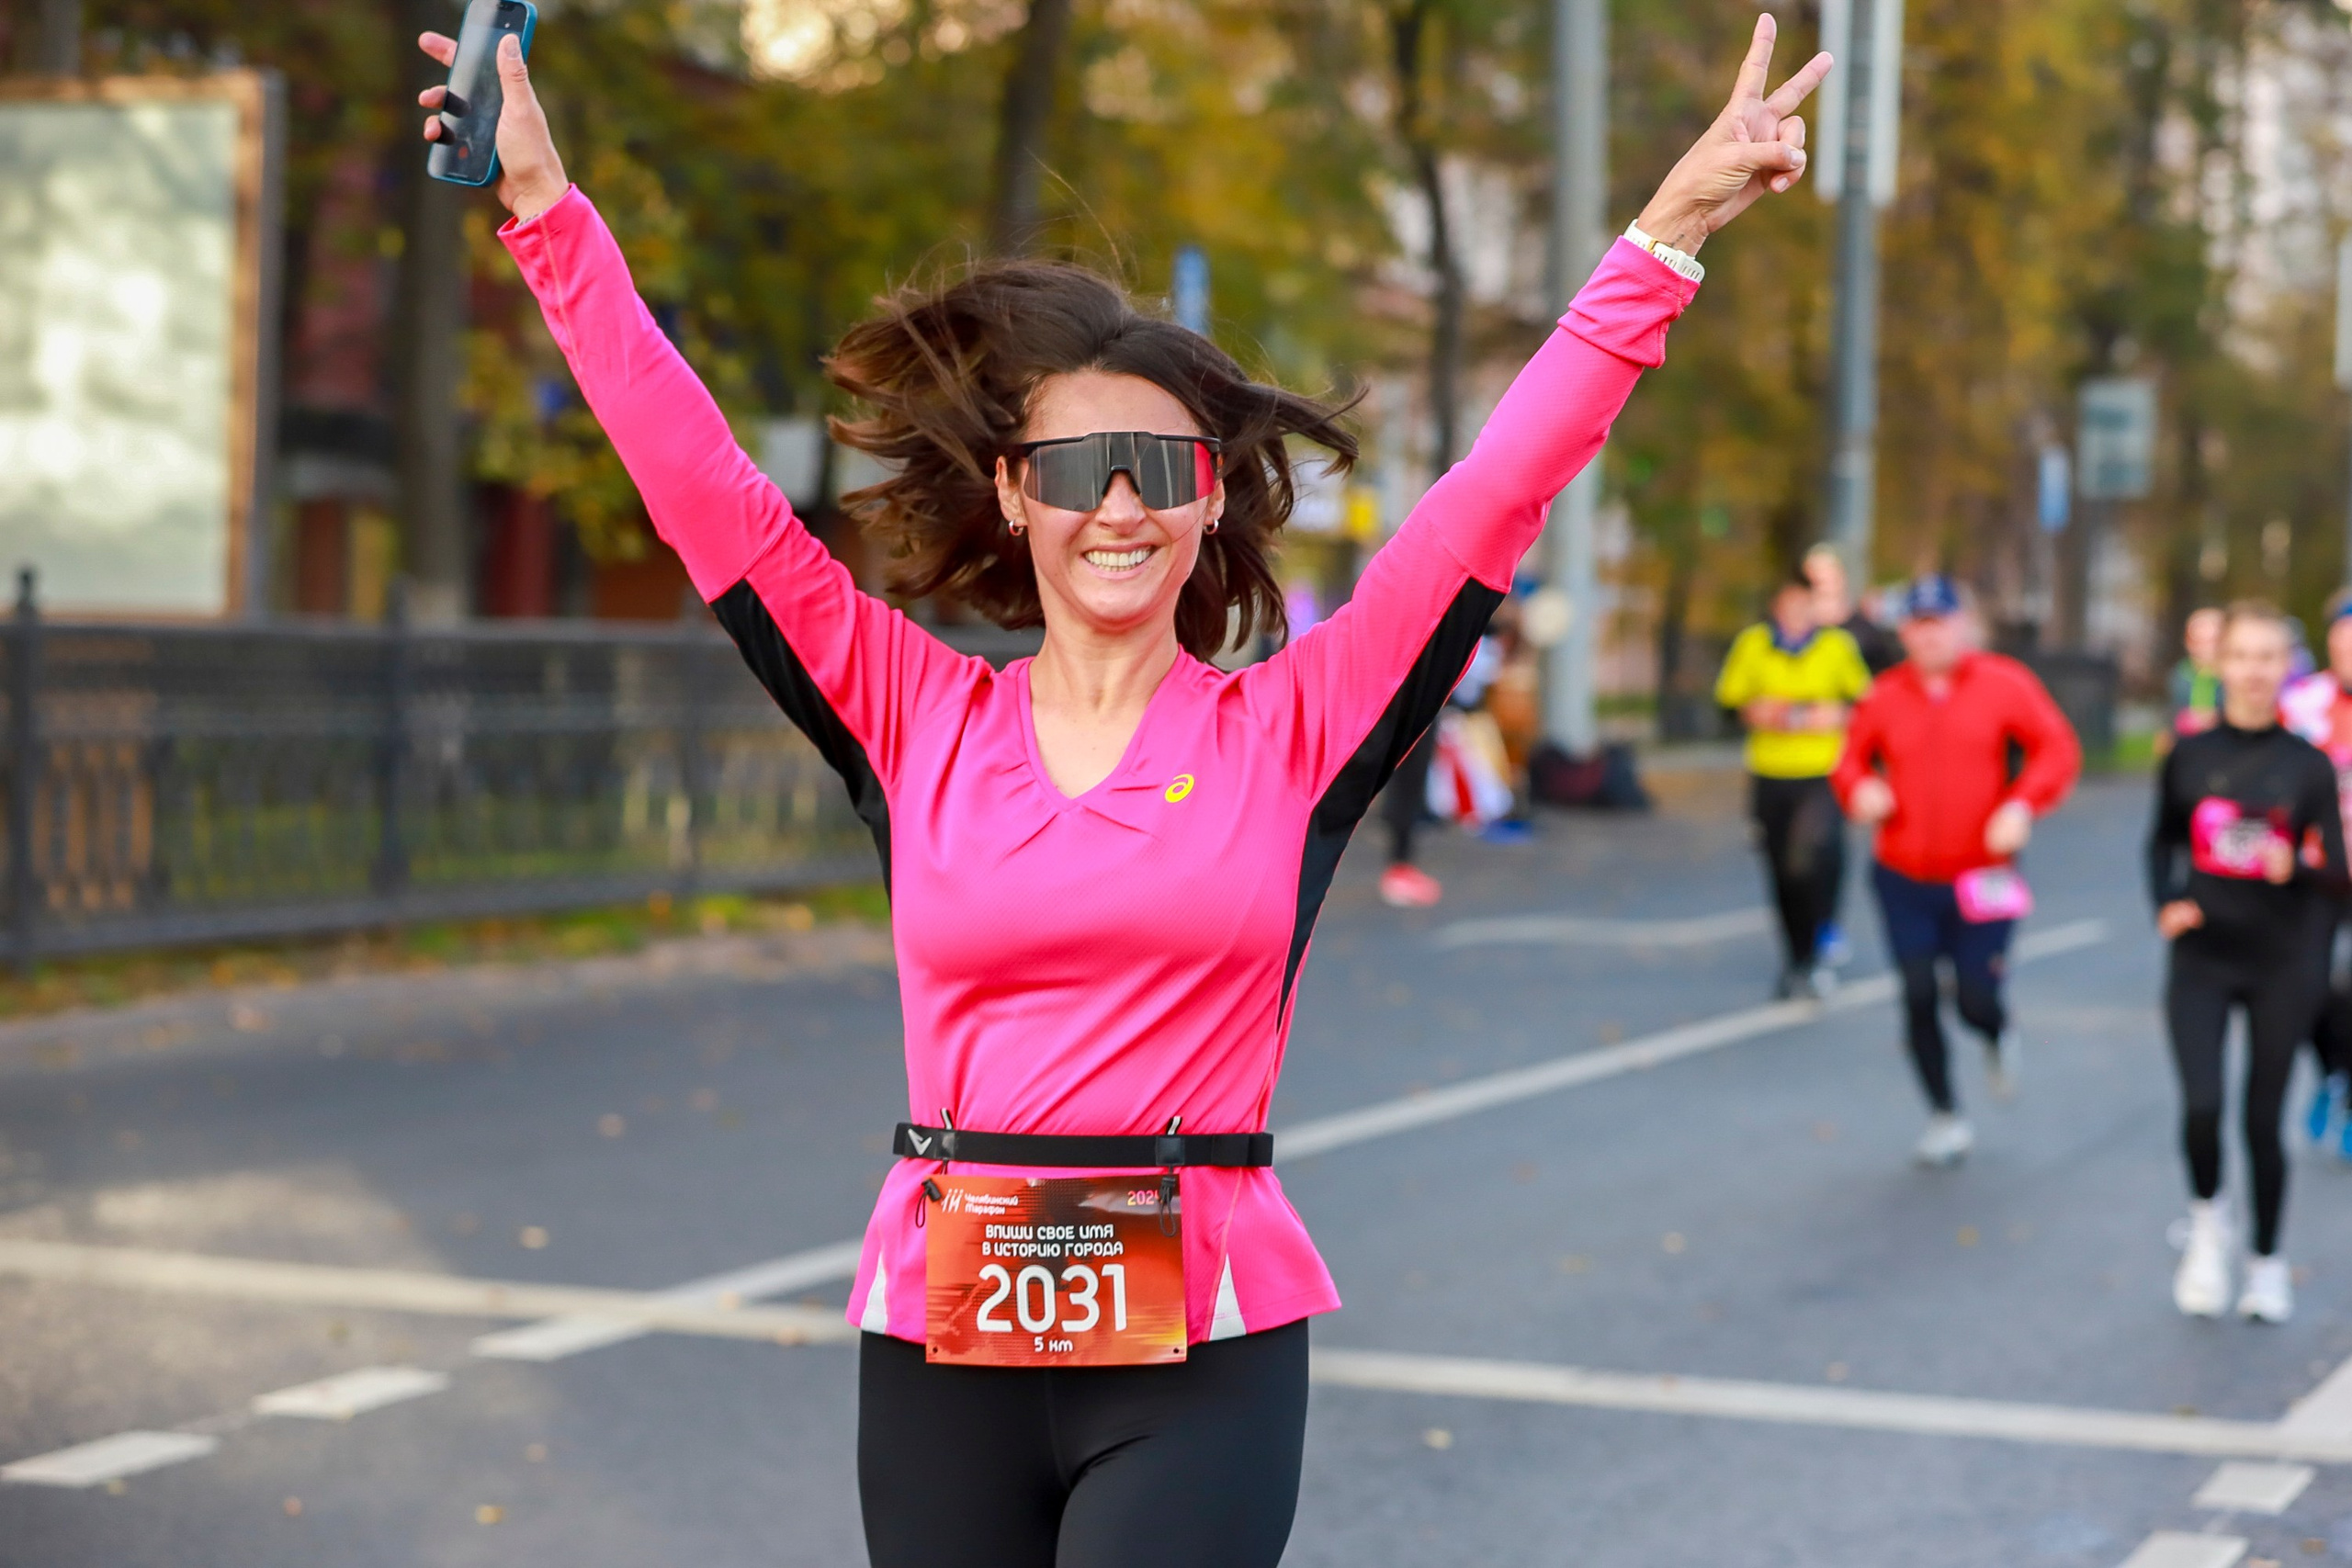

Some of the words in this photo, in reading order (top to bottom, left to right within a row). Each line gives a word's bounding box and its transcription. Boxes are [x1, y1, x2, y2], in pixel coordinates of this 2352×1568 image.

[985, 1224, 1034, 1240] ВПИШИ
[1036, 1225, 1075, 1240] СВОЕ
[1079, 1224, 1114, 1239] ИМЯ
[981, 1241, 991, 1256] В
[994, 1242, 1061, 1258] ИСТОРИЮ
[1065, 1241, 1124, 1258] ГОРОДА
[976, 1263, 1127, 1333] 2031
[1034, 1337, 1044, 1352] 5
